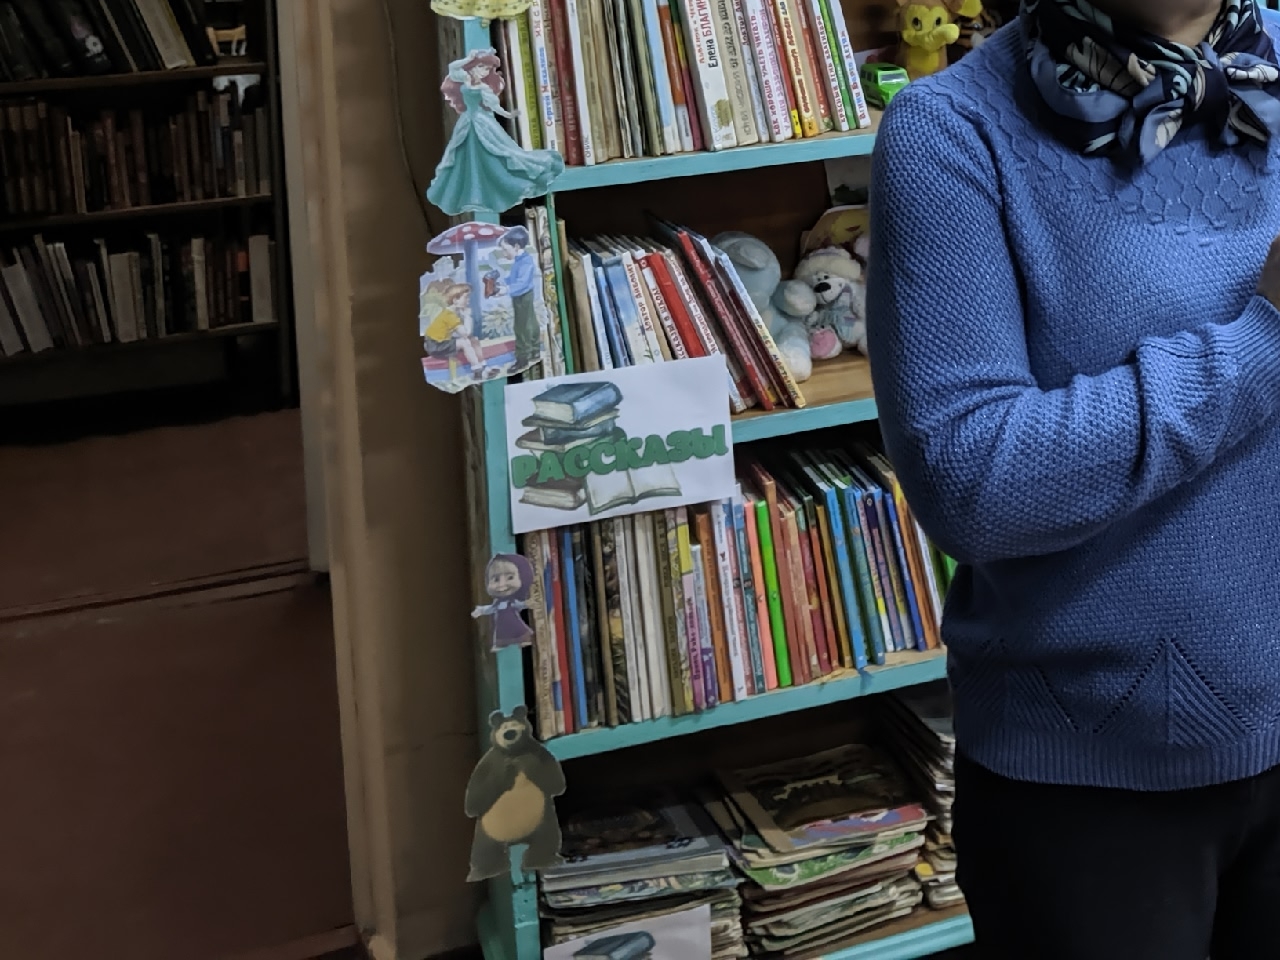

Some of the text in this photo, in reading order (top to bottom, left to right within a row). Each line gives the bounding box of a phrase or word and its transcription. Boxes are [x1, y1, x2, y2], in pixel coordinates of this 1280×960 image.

[704, 38, 719, 68] Елена
[762, 78, 777, 116] ХОРОШО
[626, 262, 653, 332] ДОКТОР АЙБОЛИТ
[668, 321, 687, 359] АССКАЗЫ
[511, 424, 729, 489] РАССКАЗЫ
